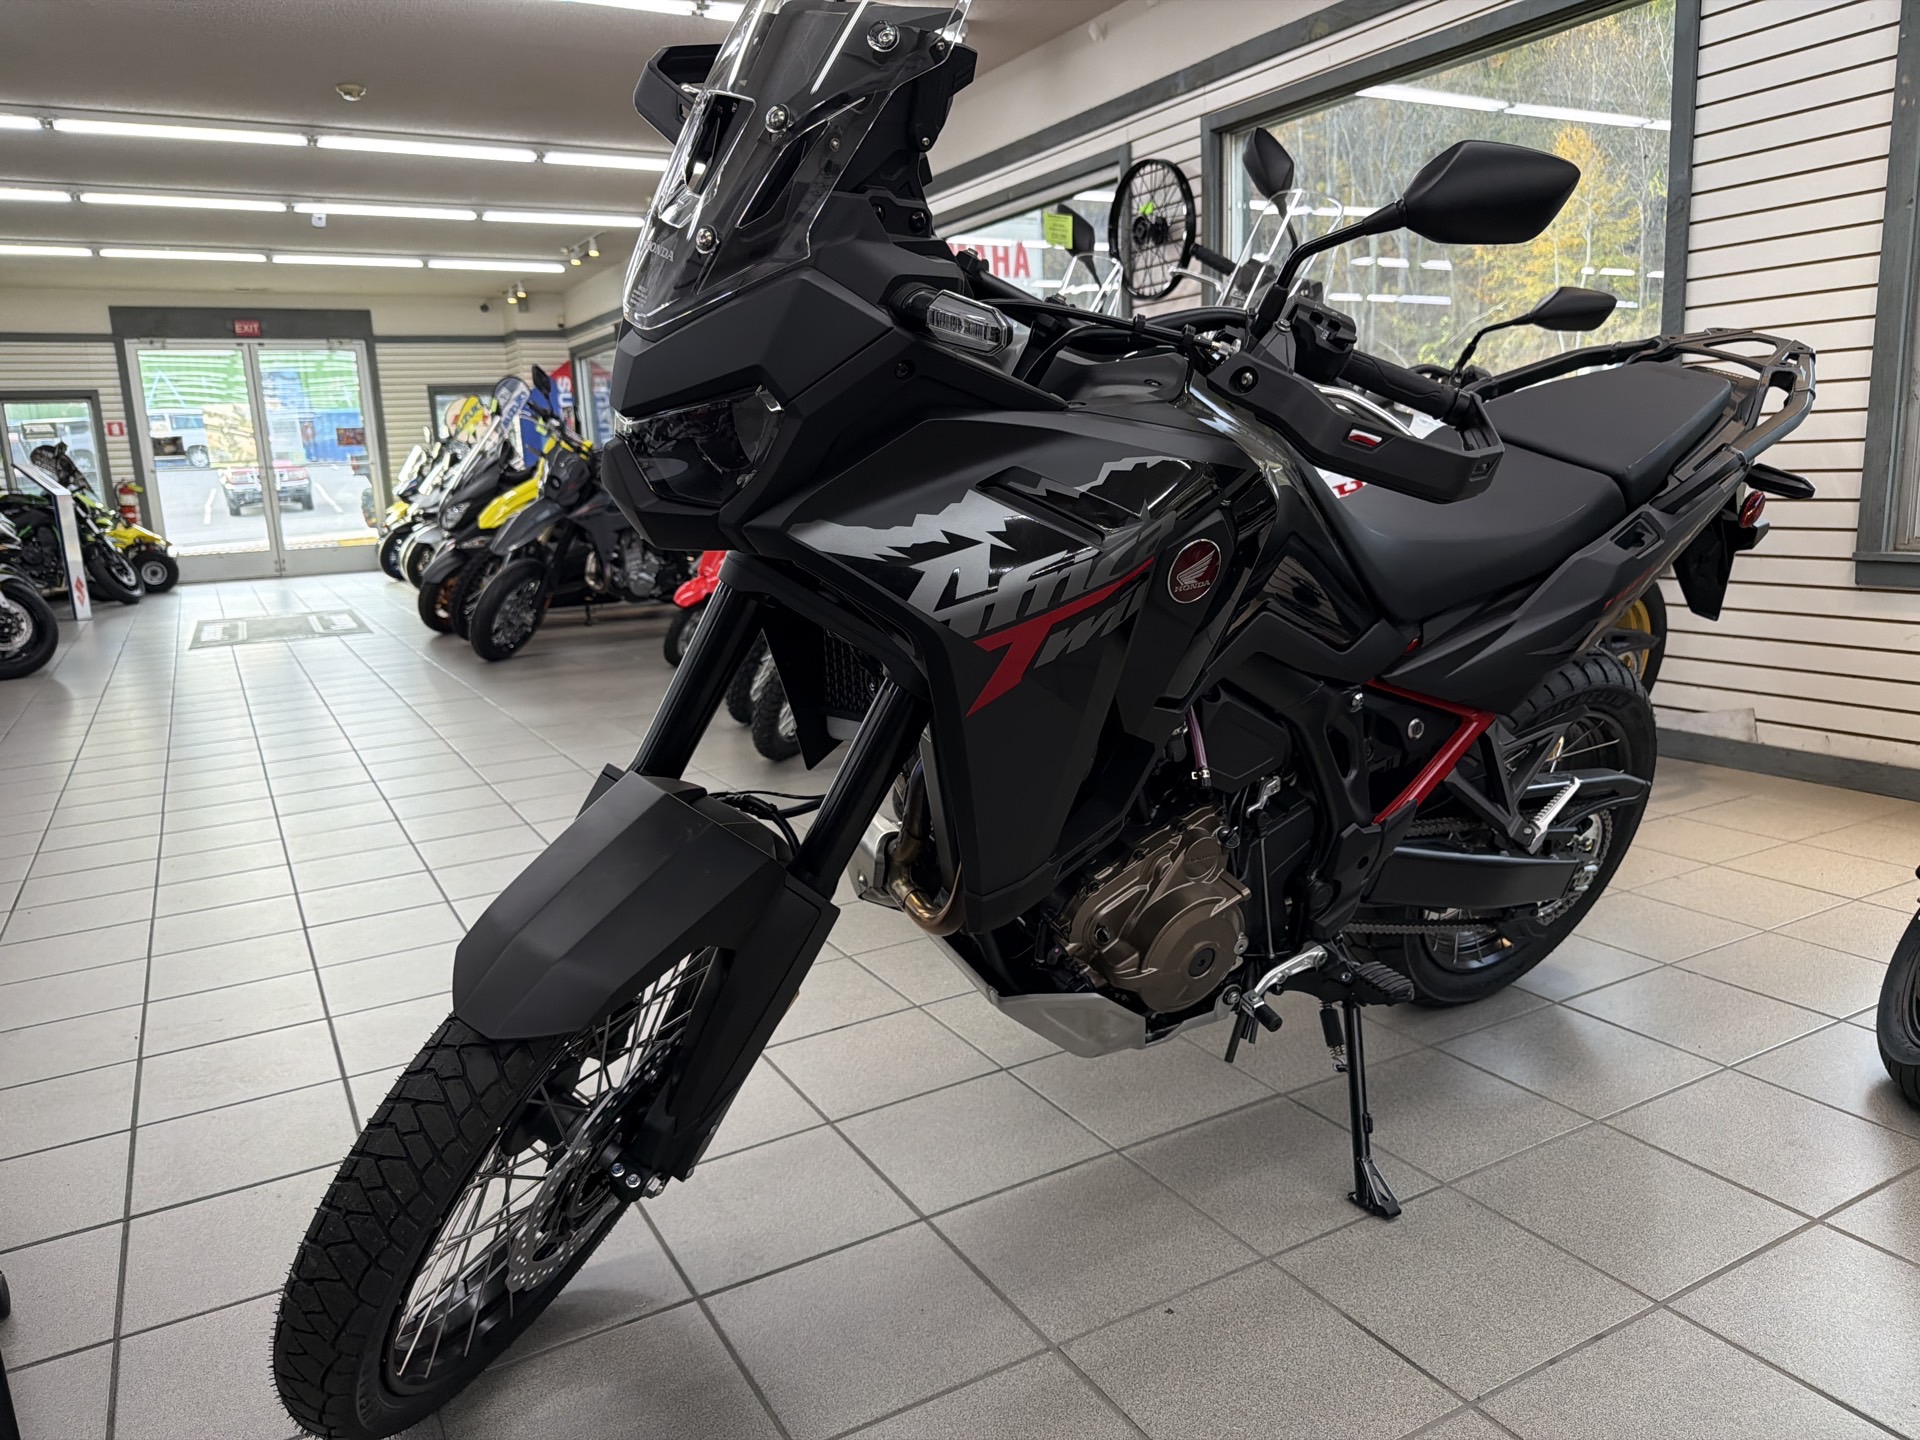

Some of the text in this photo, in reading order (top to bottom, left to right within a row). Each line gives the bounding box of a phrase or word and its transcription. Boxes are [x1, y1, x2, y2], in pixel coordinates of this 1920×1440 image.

[643, 240, 674, 262] HONDA
[235, 323, 259, 333] EXIT
[907, 506, 1177, 639] Africa
[1174, 580, 1211, 592] HONDA
[965, 556, 1156, 718] Twin
